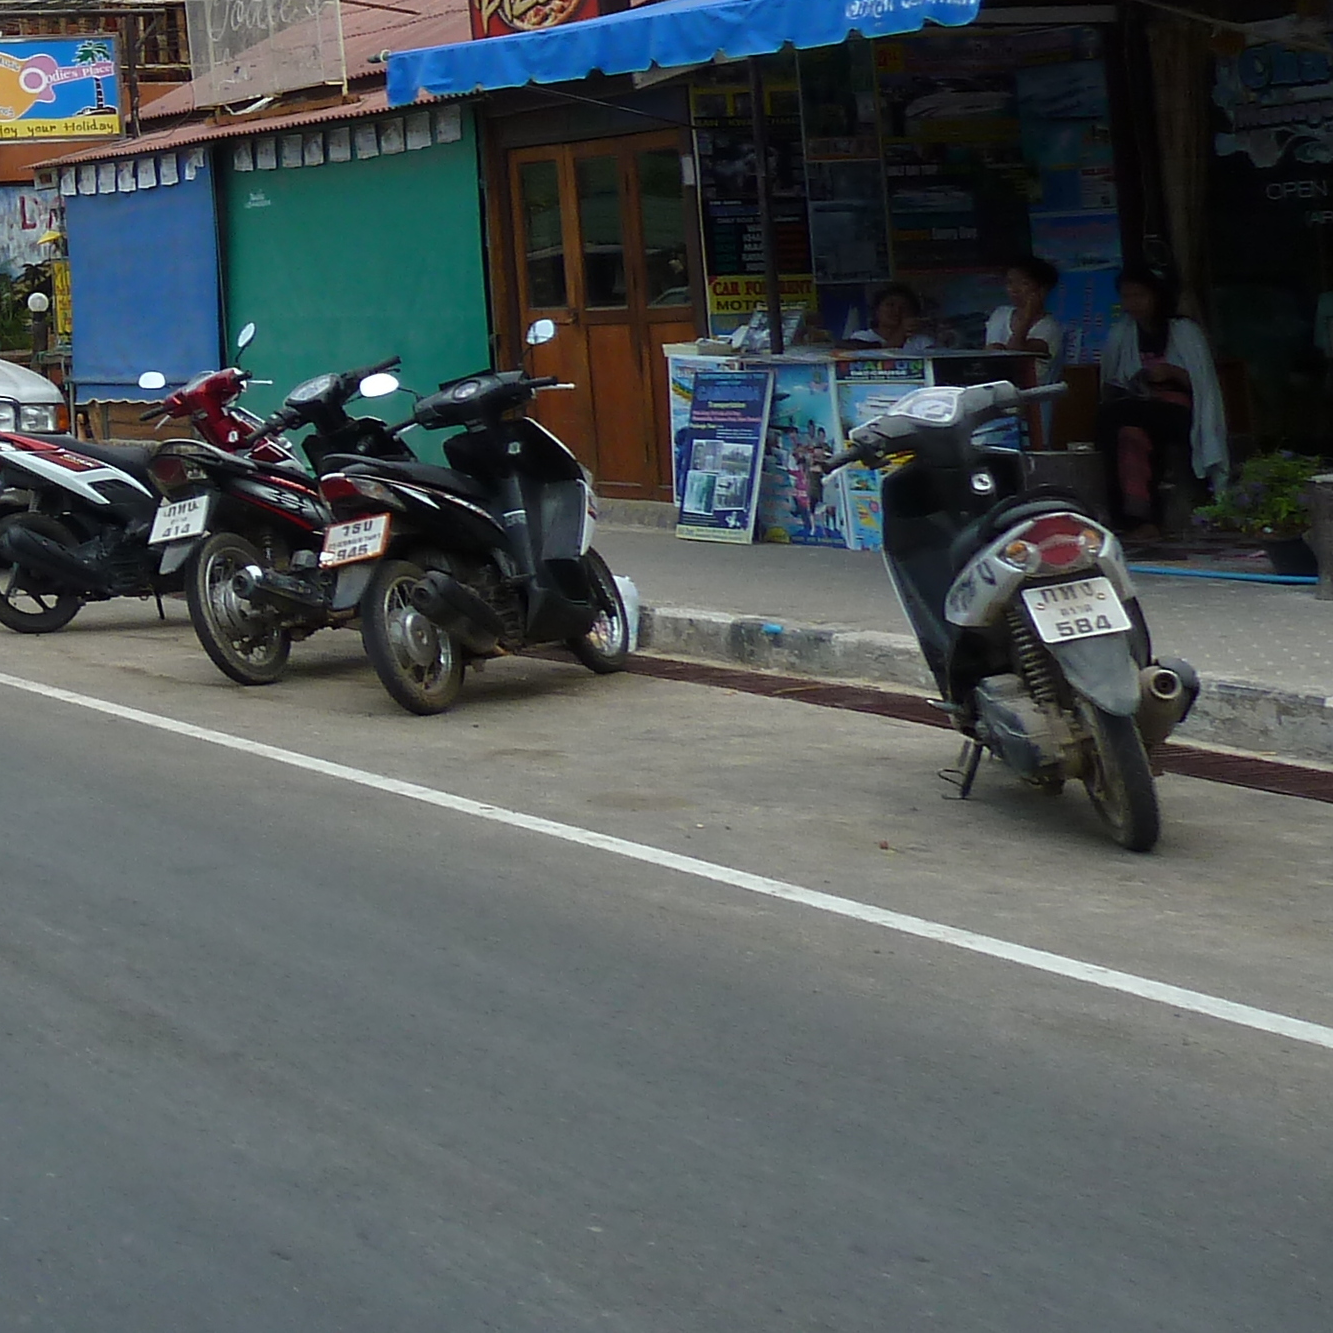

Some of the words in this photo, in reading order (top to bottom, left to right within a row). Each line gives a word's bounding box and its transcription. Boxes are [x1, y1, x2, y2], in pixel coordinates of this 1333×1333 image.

[27, 125, 57, 137] your
[64, 122, 115, 135] Holiday
[1265, 180, 1330, 201] OPEN
[1055, 615, 1111, 637] 584
